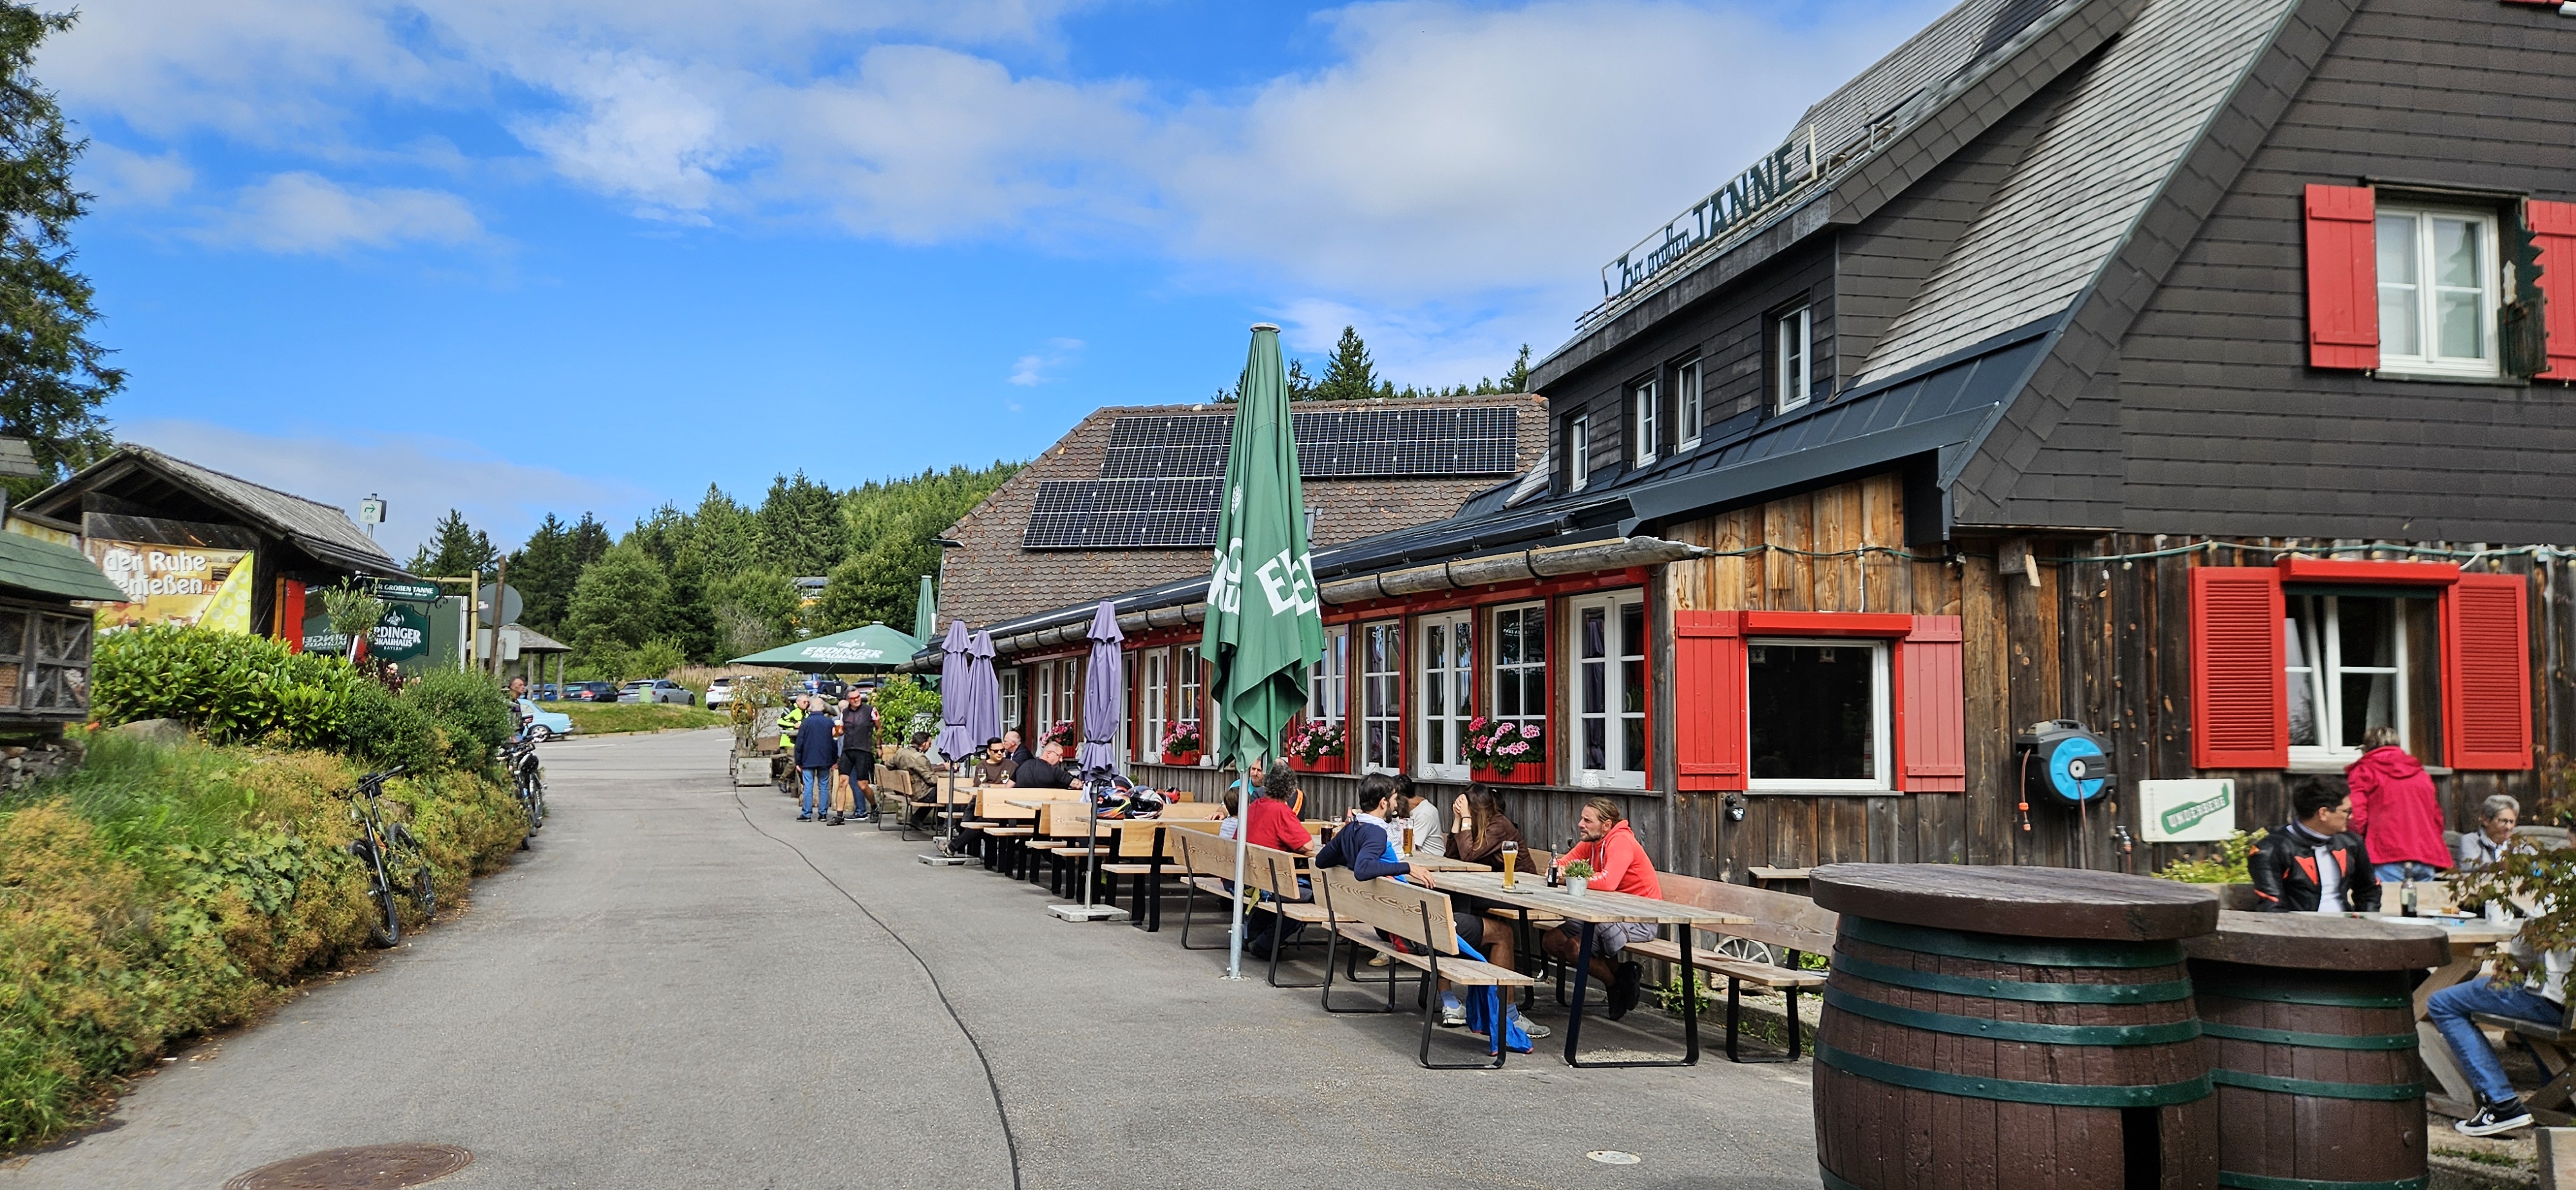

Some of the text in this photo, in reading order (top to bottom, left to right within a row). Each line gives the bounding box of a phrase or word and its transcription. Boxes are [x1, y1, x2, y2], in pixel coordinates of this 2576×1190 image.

[1689, 140, 1796, 247] TANNE
[103, 549, 143, 572] der
[149, 551, 207, 572] Ruhe
[116, 574, 204, 595] enießen
[412, 586, 434, 594] TANNE
[367, 626, 421, 644] RDINGER
[800, 646, 884, 658] ERDINGER
